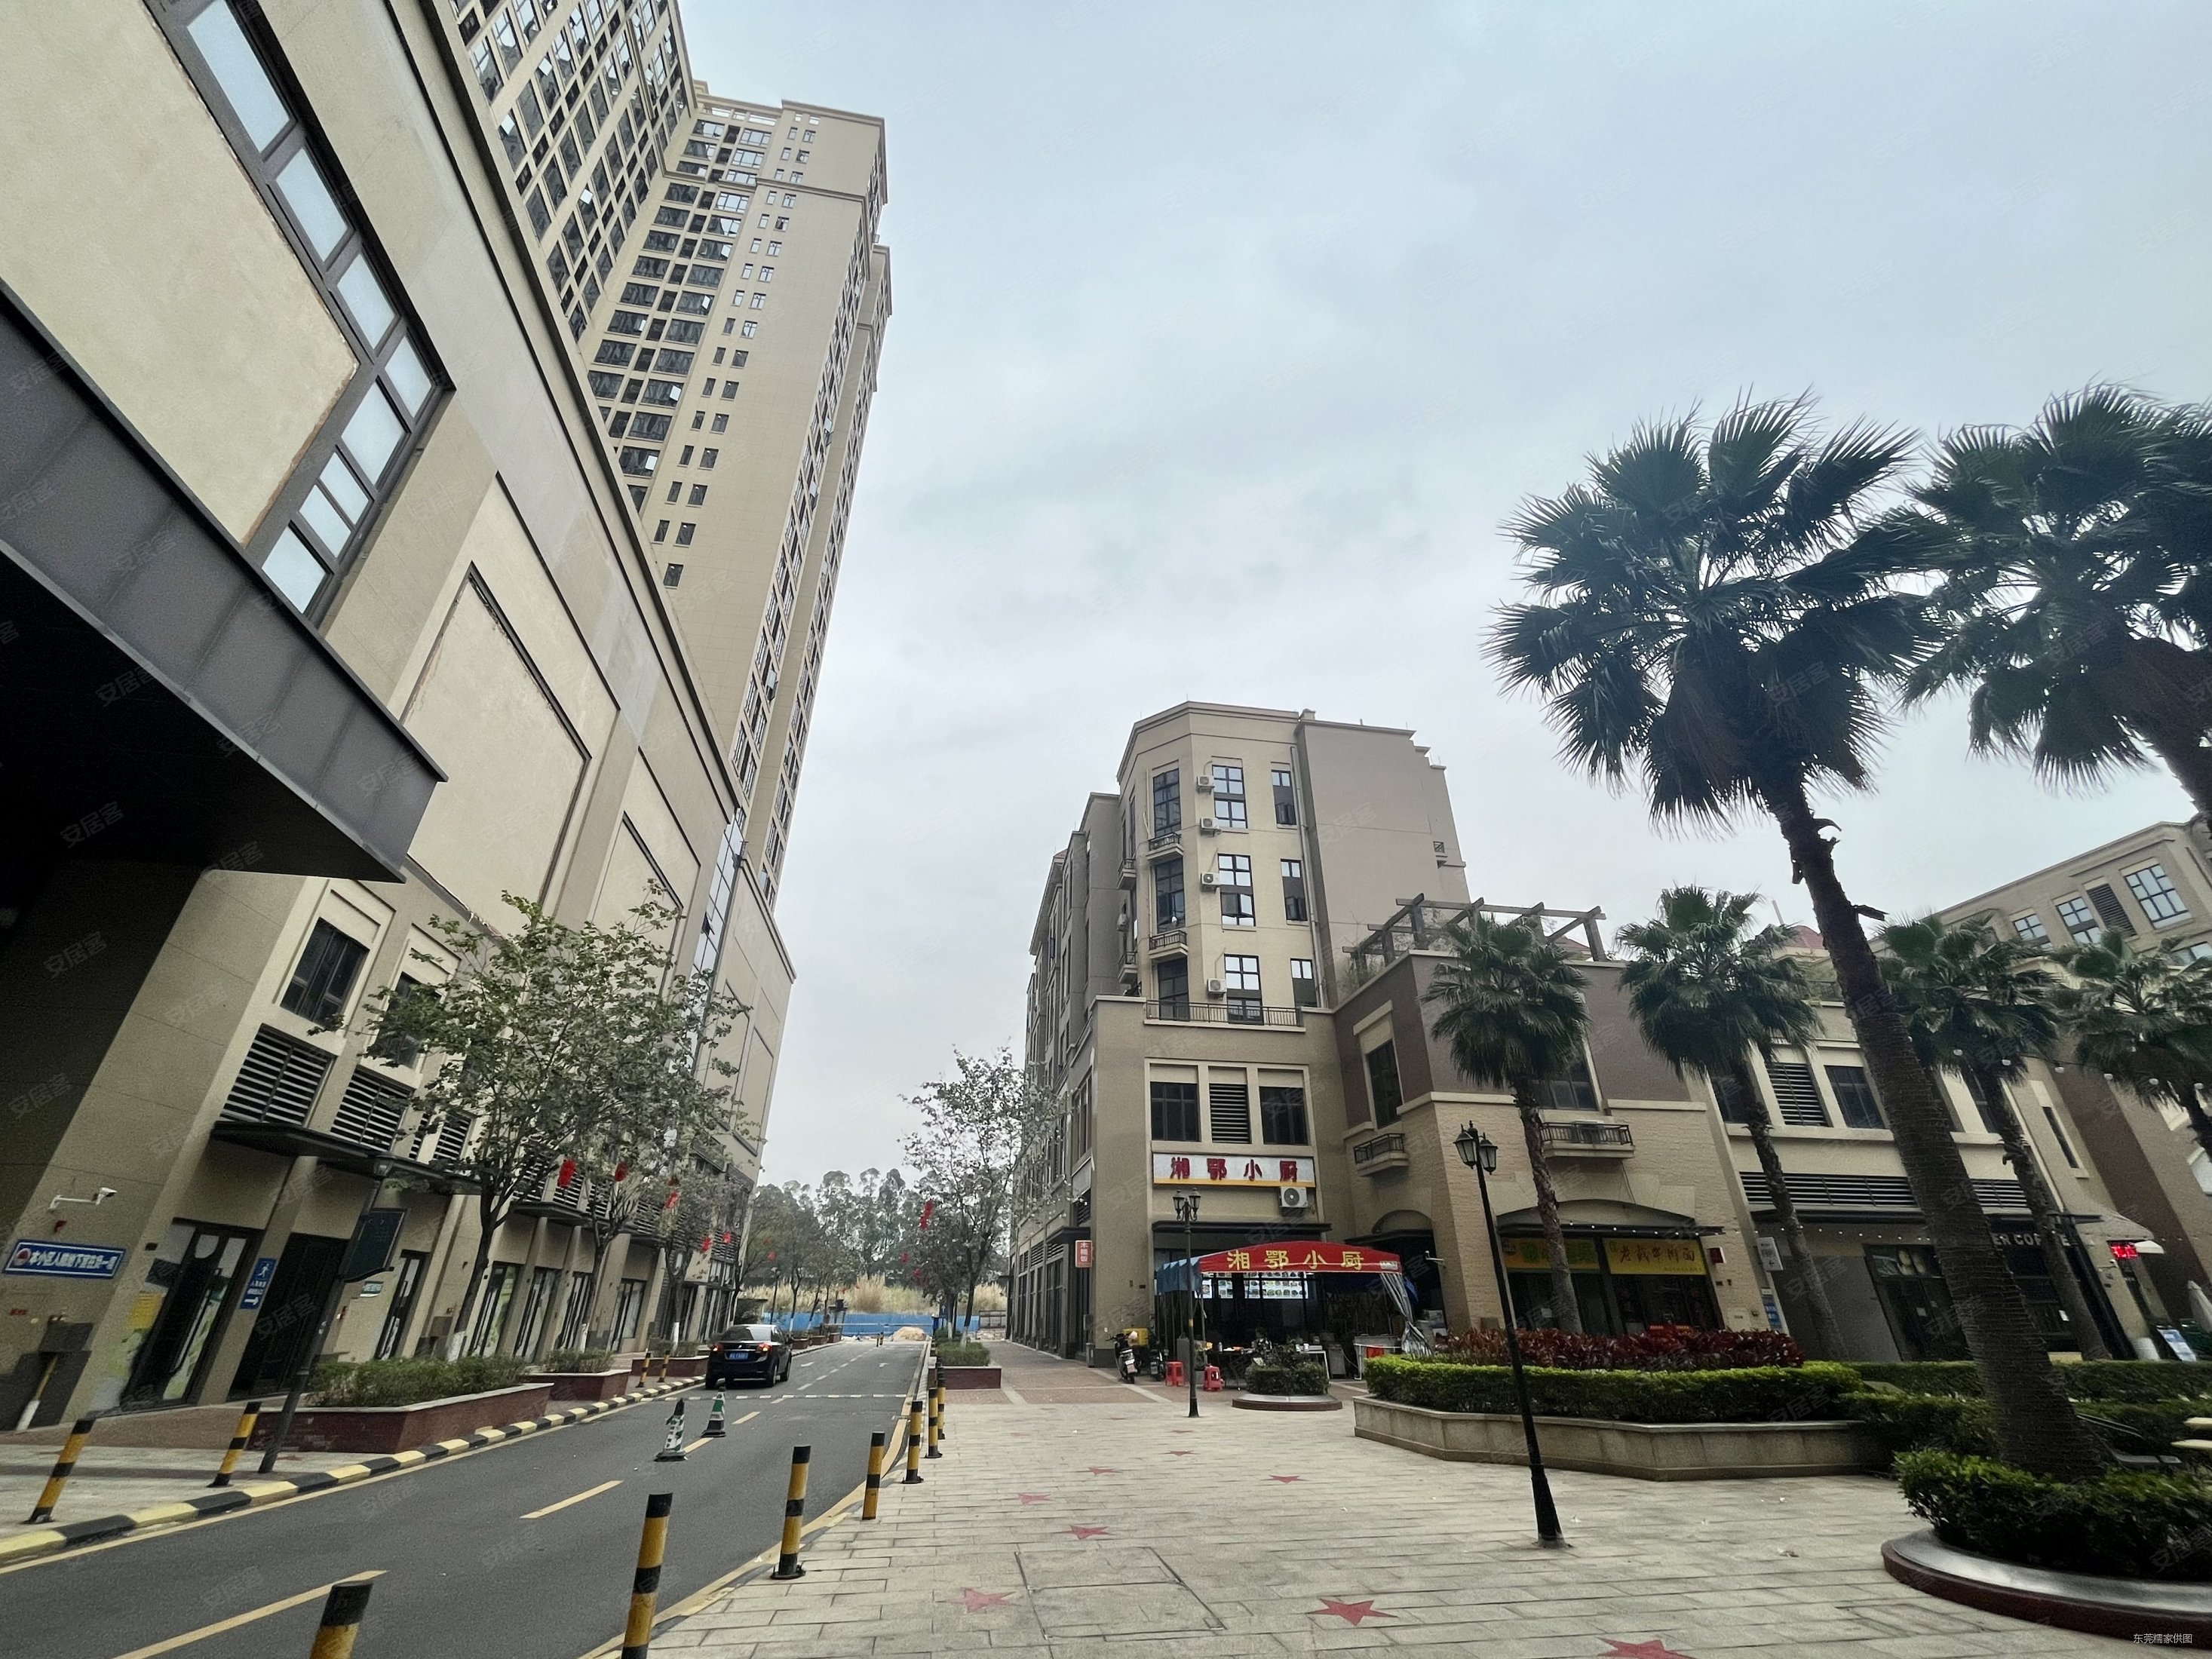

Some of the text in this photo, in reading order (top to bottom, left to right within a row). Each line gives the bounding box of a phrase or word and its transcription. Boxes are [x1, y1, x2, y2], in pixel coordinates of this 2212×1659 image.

[1170, 1156, 1298, 1182] 湘鄂小厨
[2014, 1232, 2071, 1247] COFE
[1226, 1249, 1364, 1271] 湘鄂小厨
